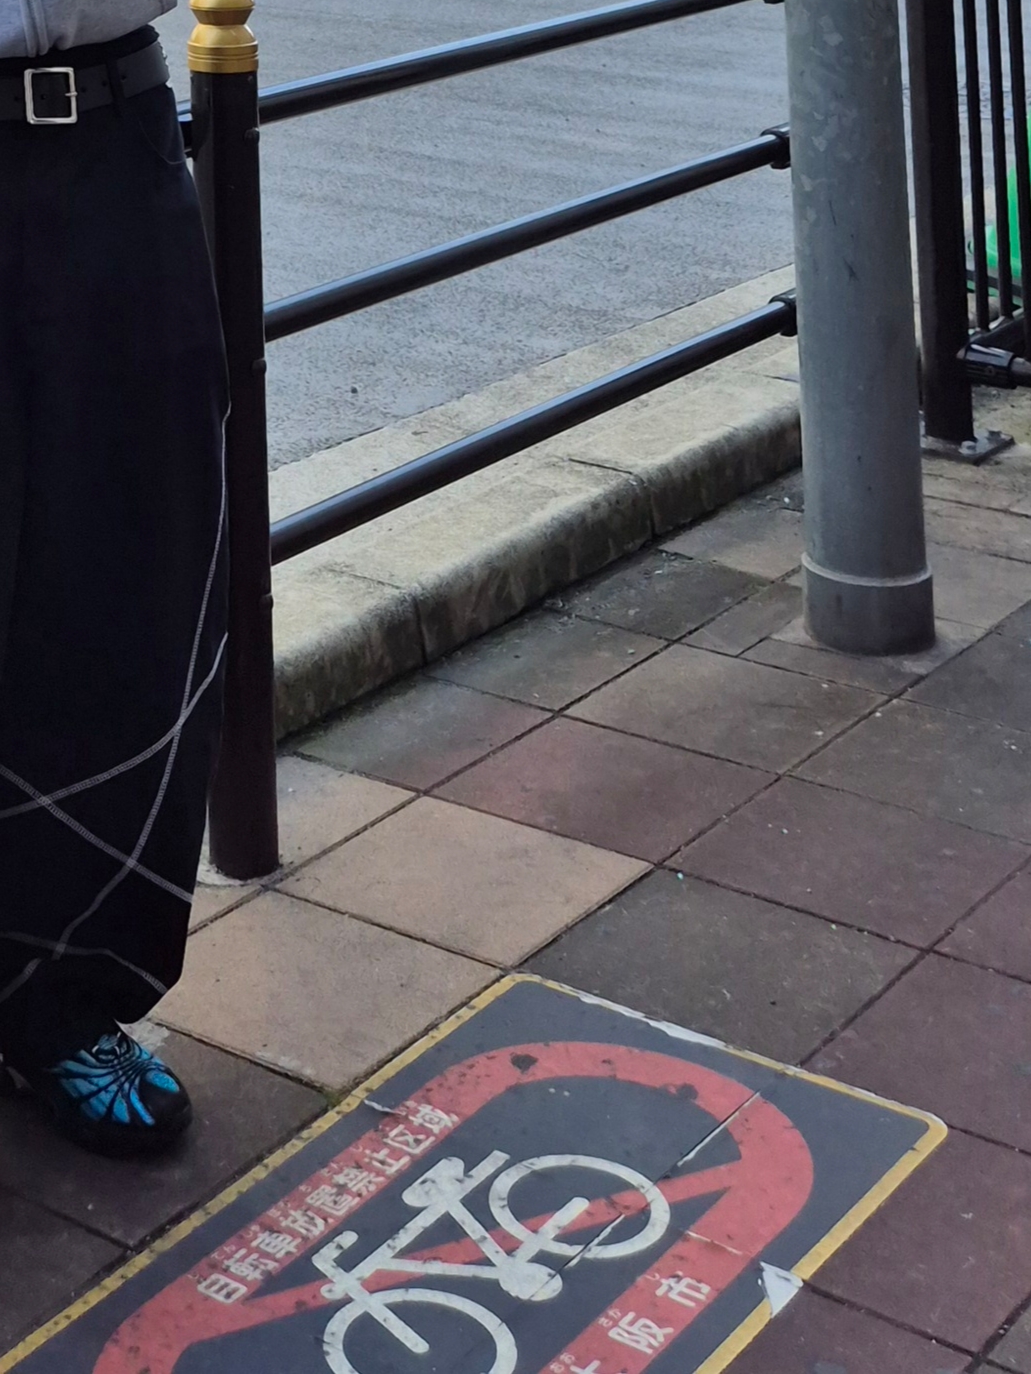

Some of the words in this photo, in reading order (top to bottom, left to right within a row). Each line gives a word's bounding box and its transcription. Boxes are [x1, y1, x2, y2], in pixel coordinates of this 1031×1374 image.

[197, 1104, 460, 1304] 自転車放置禁止区域
